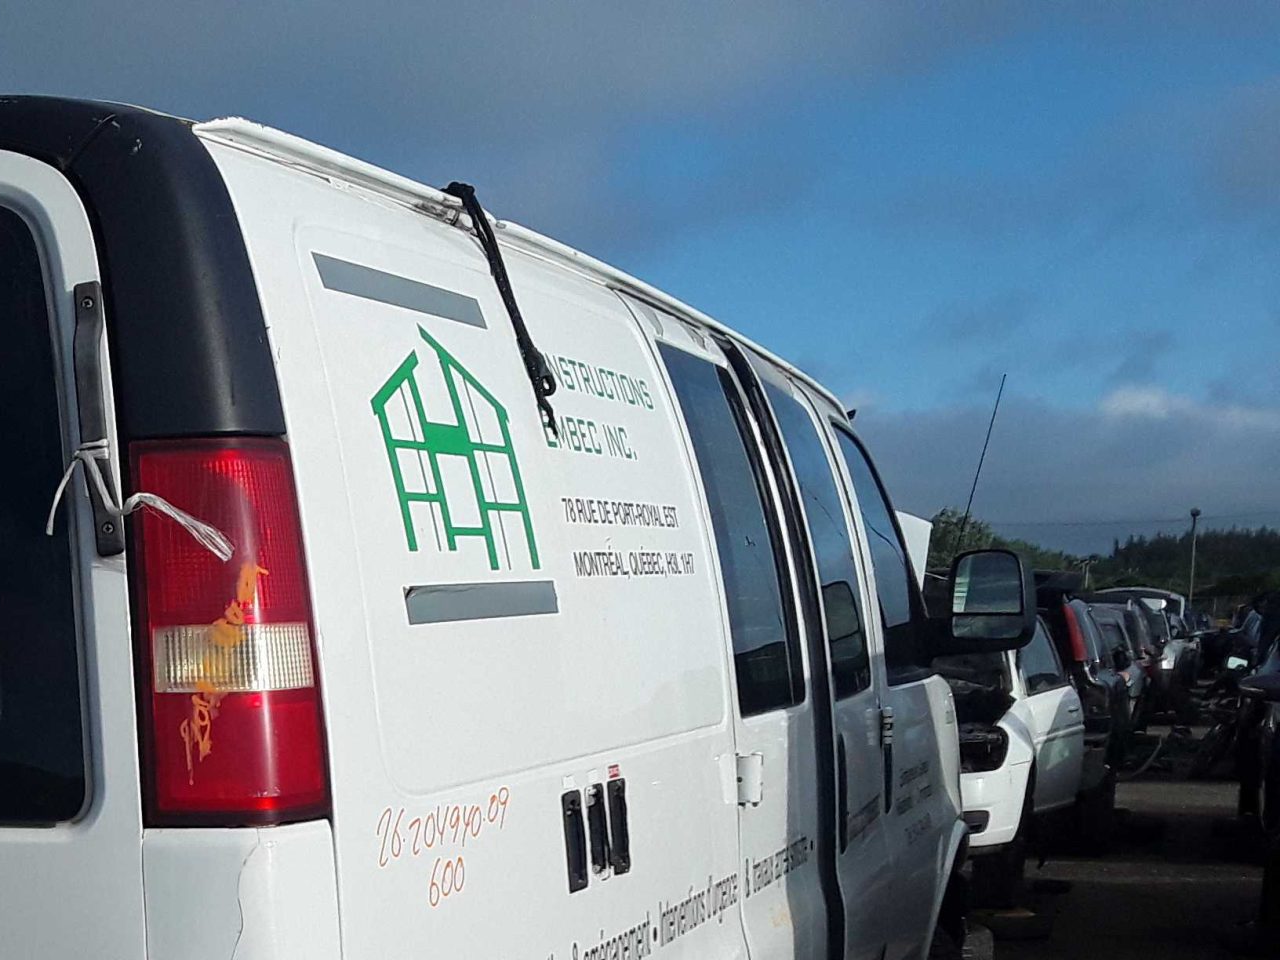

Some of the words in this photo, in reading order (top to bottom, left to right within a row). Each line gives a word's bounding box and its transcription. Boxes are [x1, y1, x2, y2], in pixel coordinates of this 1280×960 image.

[545, 351, 654, 410] NSTRUCTIONS
[602, 424, 638, 460] INC.
[561, 498, 576, 523] 78
[575, 498, 599, 524] RUE
[597, 500, 613, 525] DE
[611, 501, 665, 528] PORT-ROYAL
[662, 506, 679, 528] EST
[573, 545, 631, 580] MONTRÉAL,
[628, 546, 668, 578] QUÉBEC,
[429, 856, 465, 907] 600
